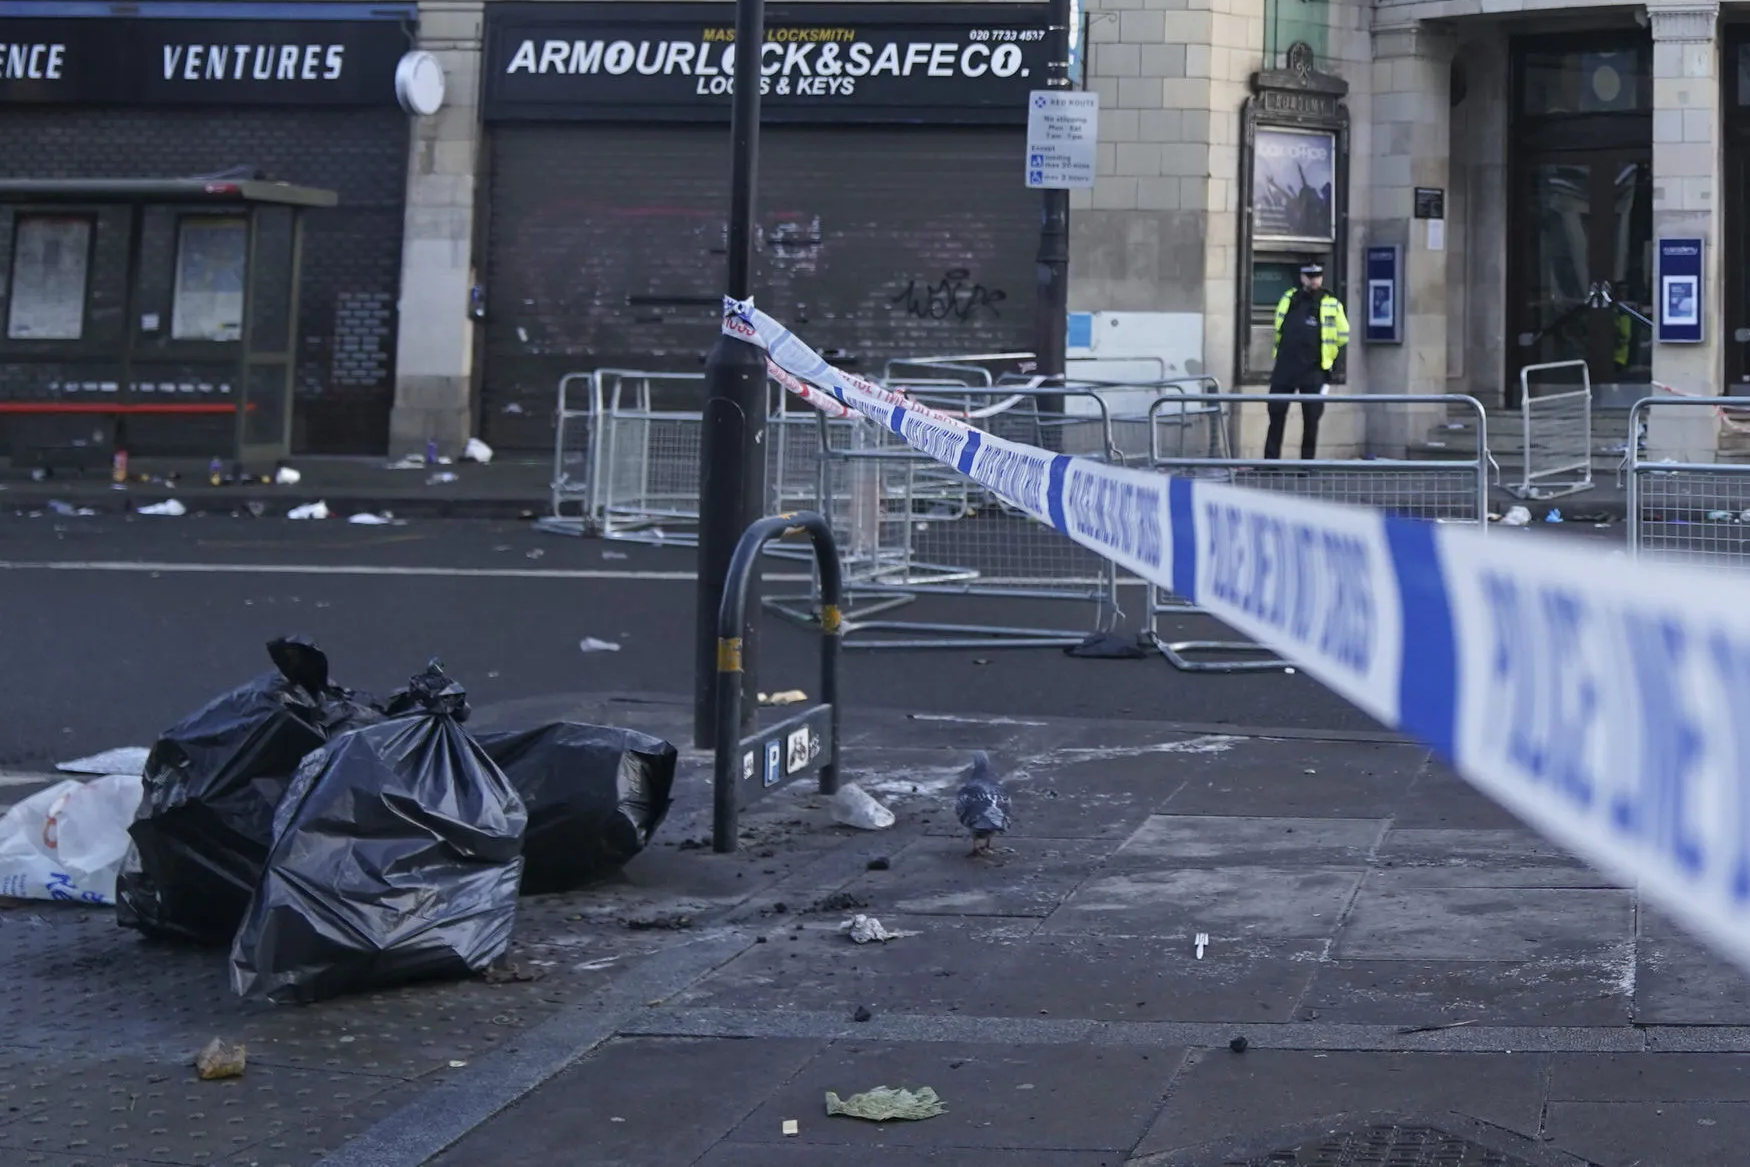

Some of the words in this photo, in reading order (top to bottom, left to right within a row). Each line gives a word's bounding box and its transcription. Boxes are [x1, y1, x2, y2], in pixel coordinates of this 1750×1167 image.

[767, 28, 855, 42] LOCKSMITH
[969, 28, 990, 41] 020
[163, 43, 345, 81] VENTURES
[696, 75, 771, 95] LOS
[775, 76, 791, 95] &
[796, 76, 856, 95] KEYS
[768, 745, 780, 782] P
